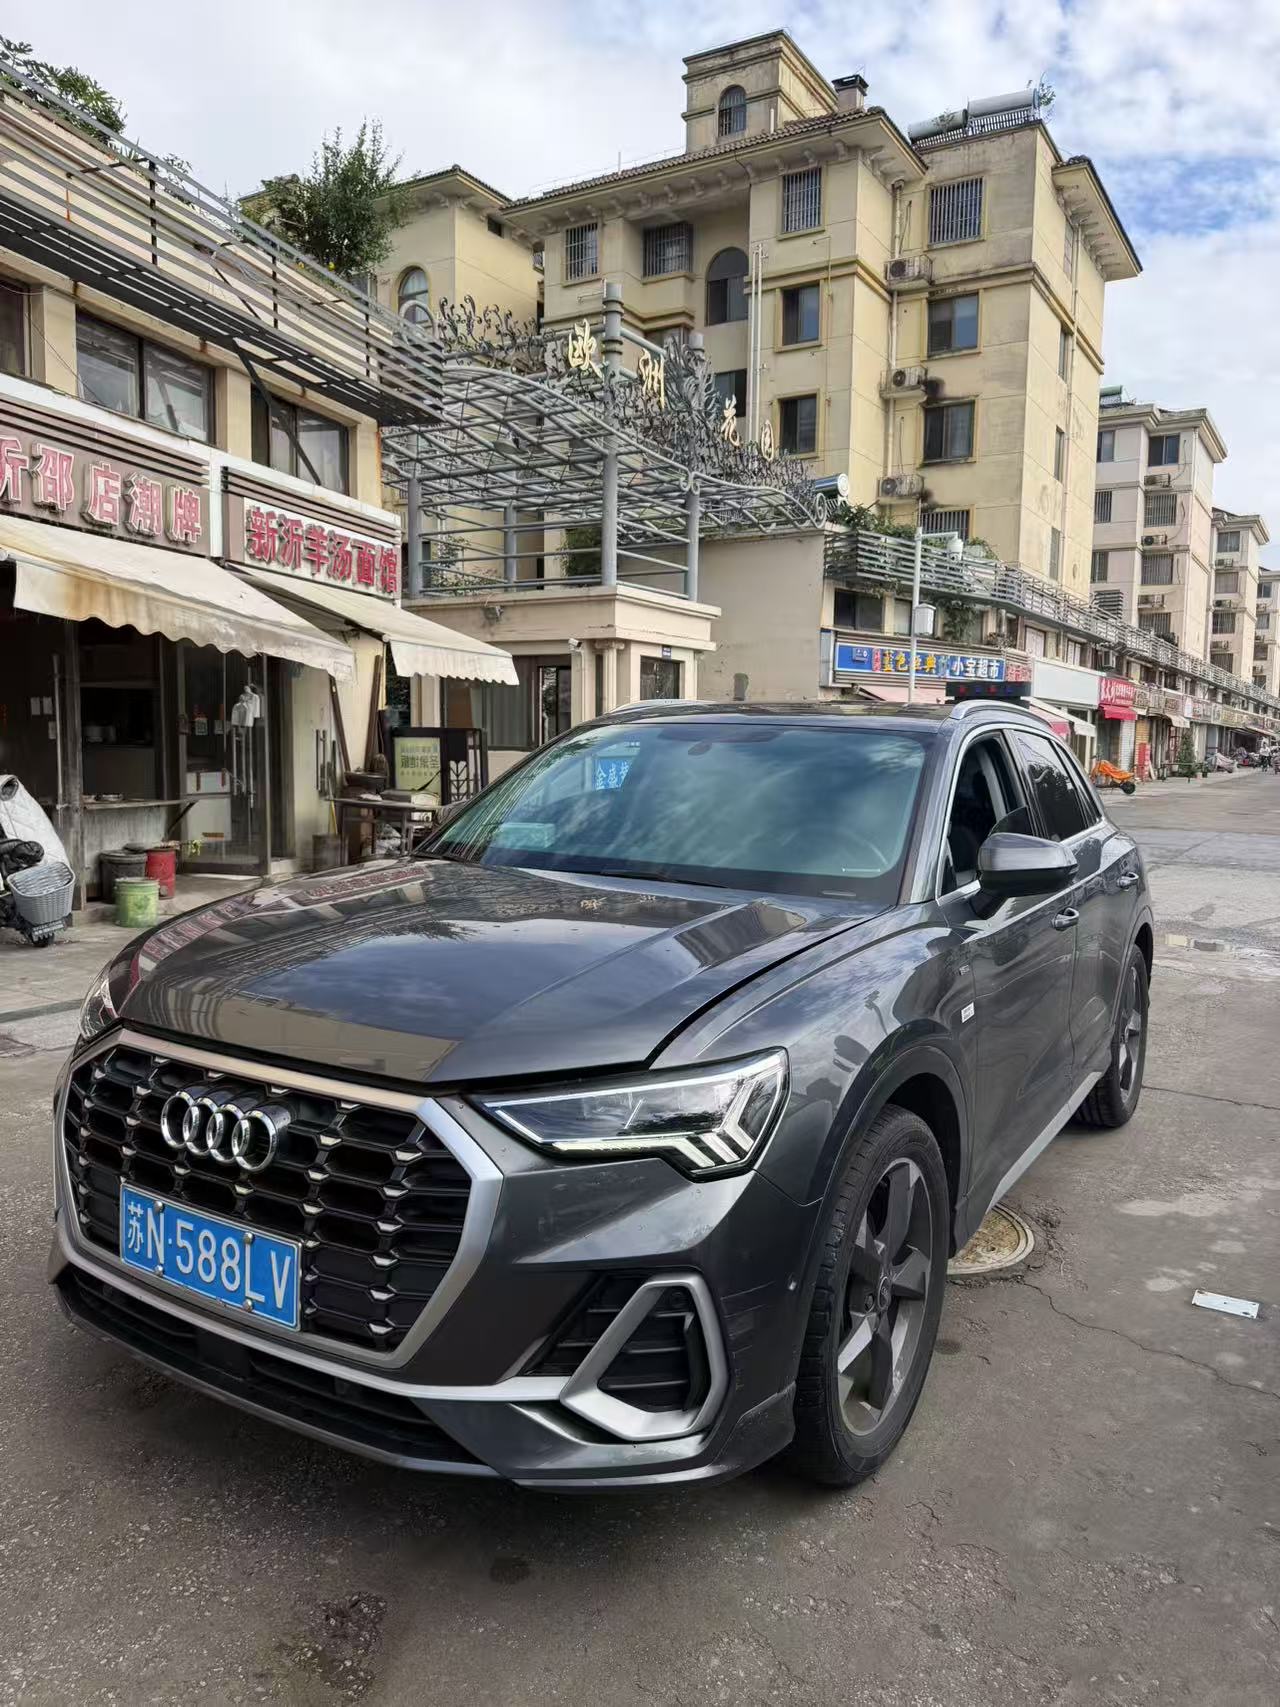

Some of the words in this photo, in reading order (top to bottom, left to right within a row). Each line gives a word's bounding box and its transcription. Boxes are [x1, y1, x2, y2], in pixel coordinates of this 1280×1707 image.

[247, 506, 398, 593] 新沂羊汤面馆
[952, 655, 1000, 678] 小宝超市
[127, 1201, 292, 1309] 苏N·588LV
